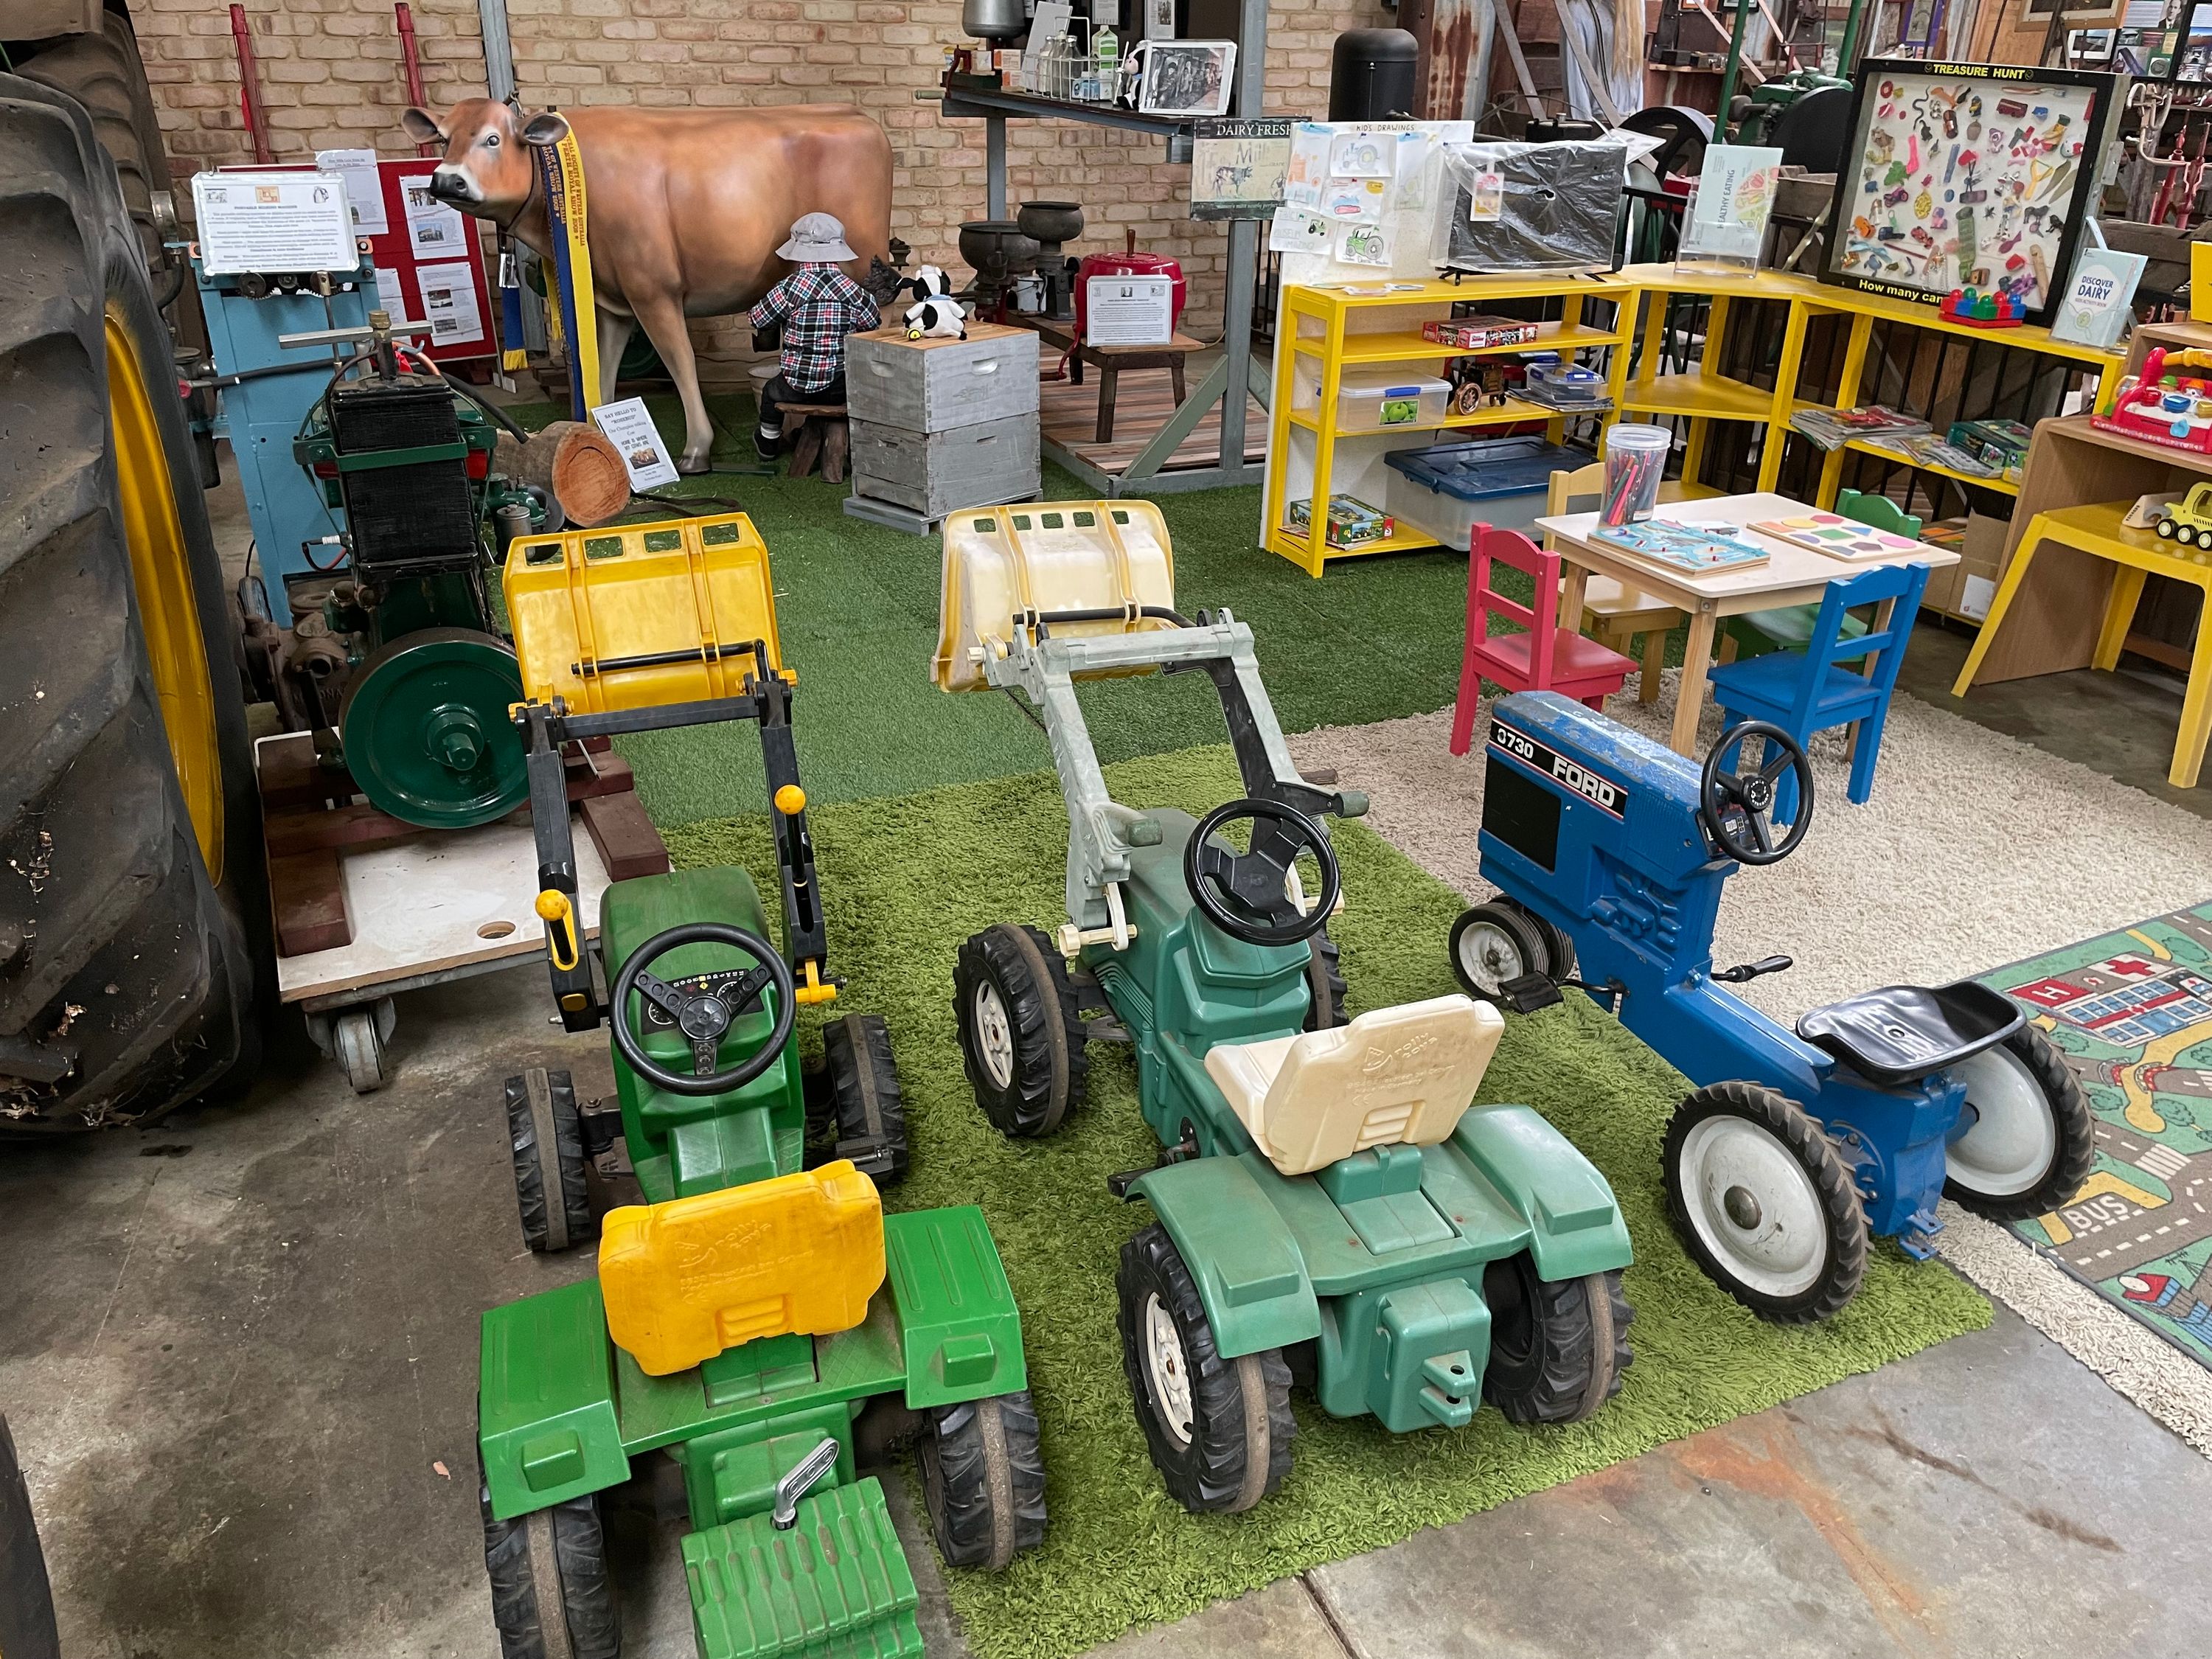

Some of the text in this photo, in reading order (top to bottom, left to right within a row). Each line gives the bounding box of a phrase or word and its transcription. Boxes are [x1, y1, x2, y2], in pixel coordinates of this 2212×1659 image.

[1933, 64, 2025, 80] TREASURE HUNT
[1217, 124, 1254, 136] DAIRY
[562, 143, 572, 169] PERTH
[571, 153, 579, 178] SOCIETY
[567, 169, 576, 194] ROYAL
[558, 192, 566, 224] AUSTRALIA
[570, 195, 578, 215] SHOW
[1717, 170, 1735, 229] HEALTHY EATING
[1859, 279, 1943, 304] How many can
[2077, 285, 2110, 300] DAIRY
[2081, 276, 2114, 288] DISCOVER
[1552, 756, 1615, 807] FORD
[2031, 986, 2071, 1000] H
[2065, 1197, 2128, 1228] BUS
